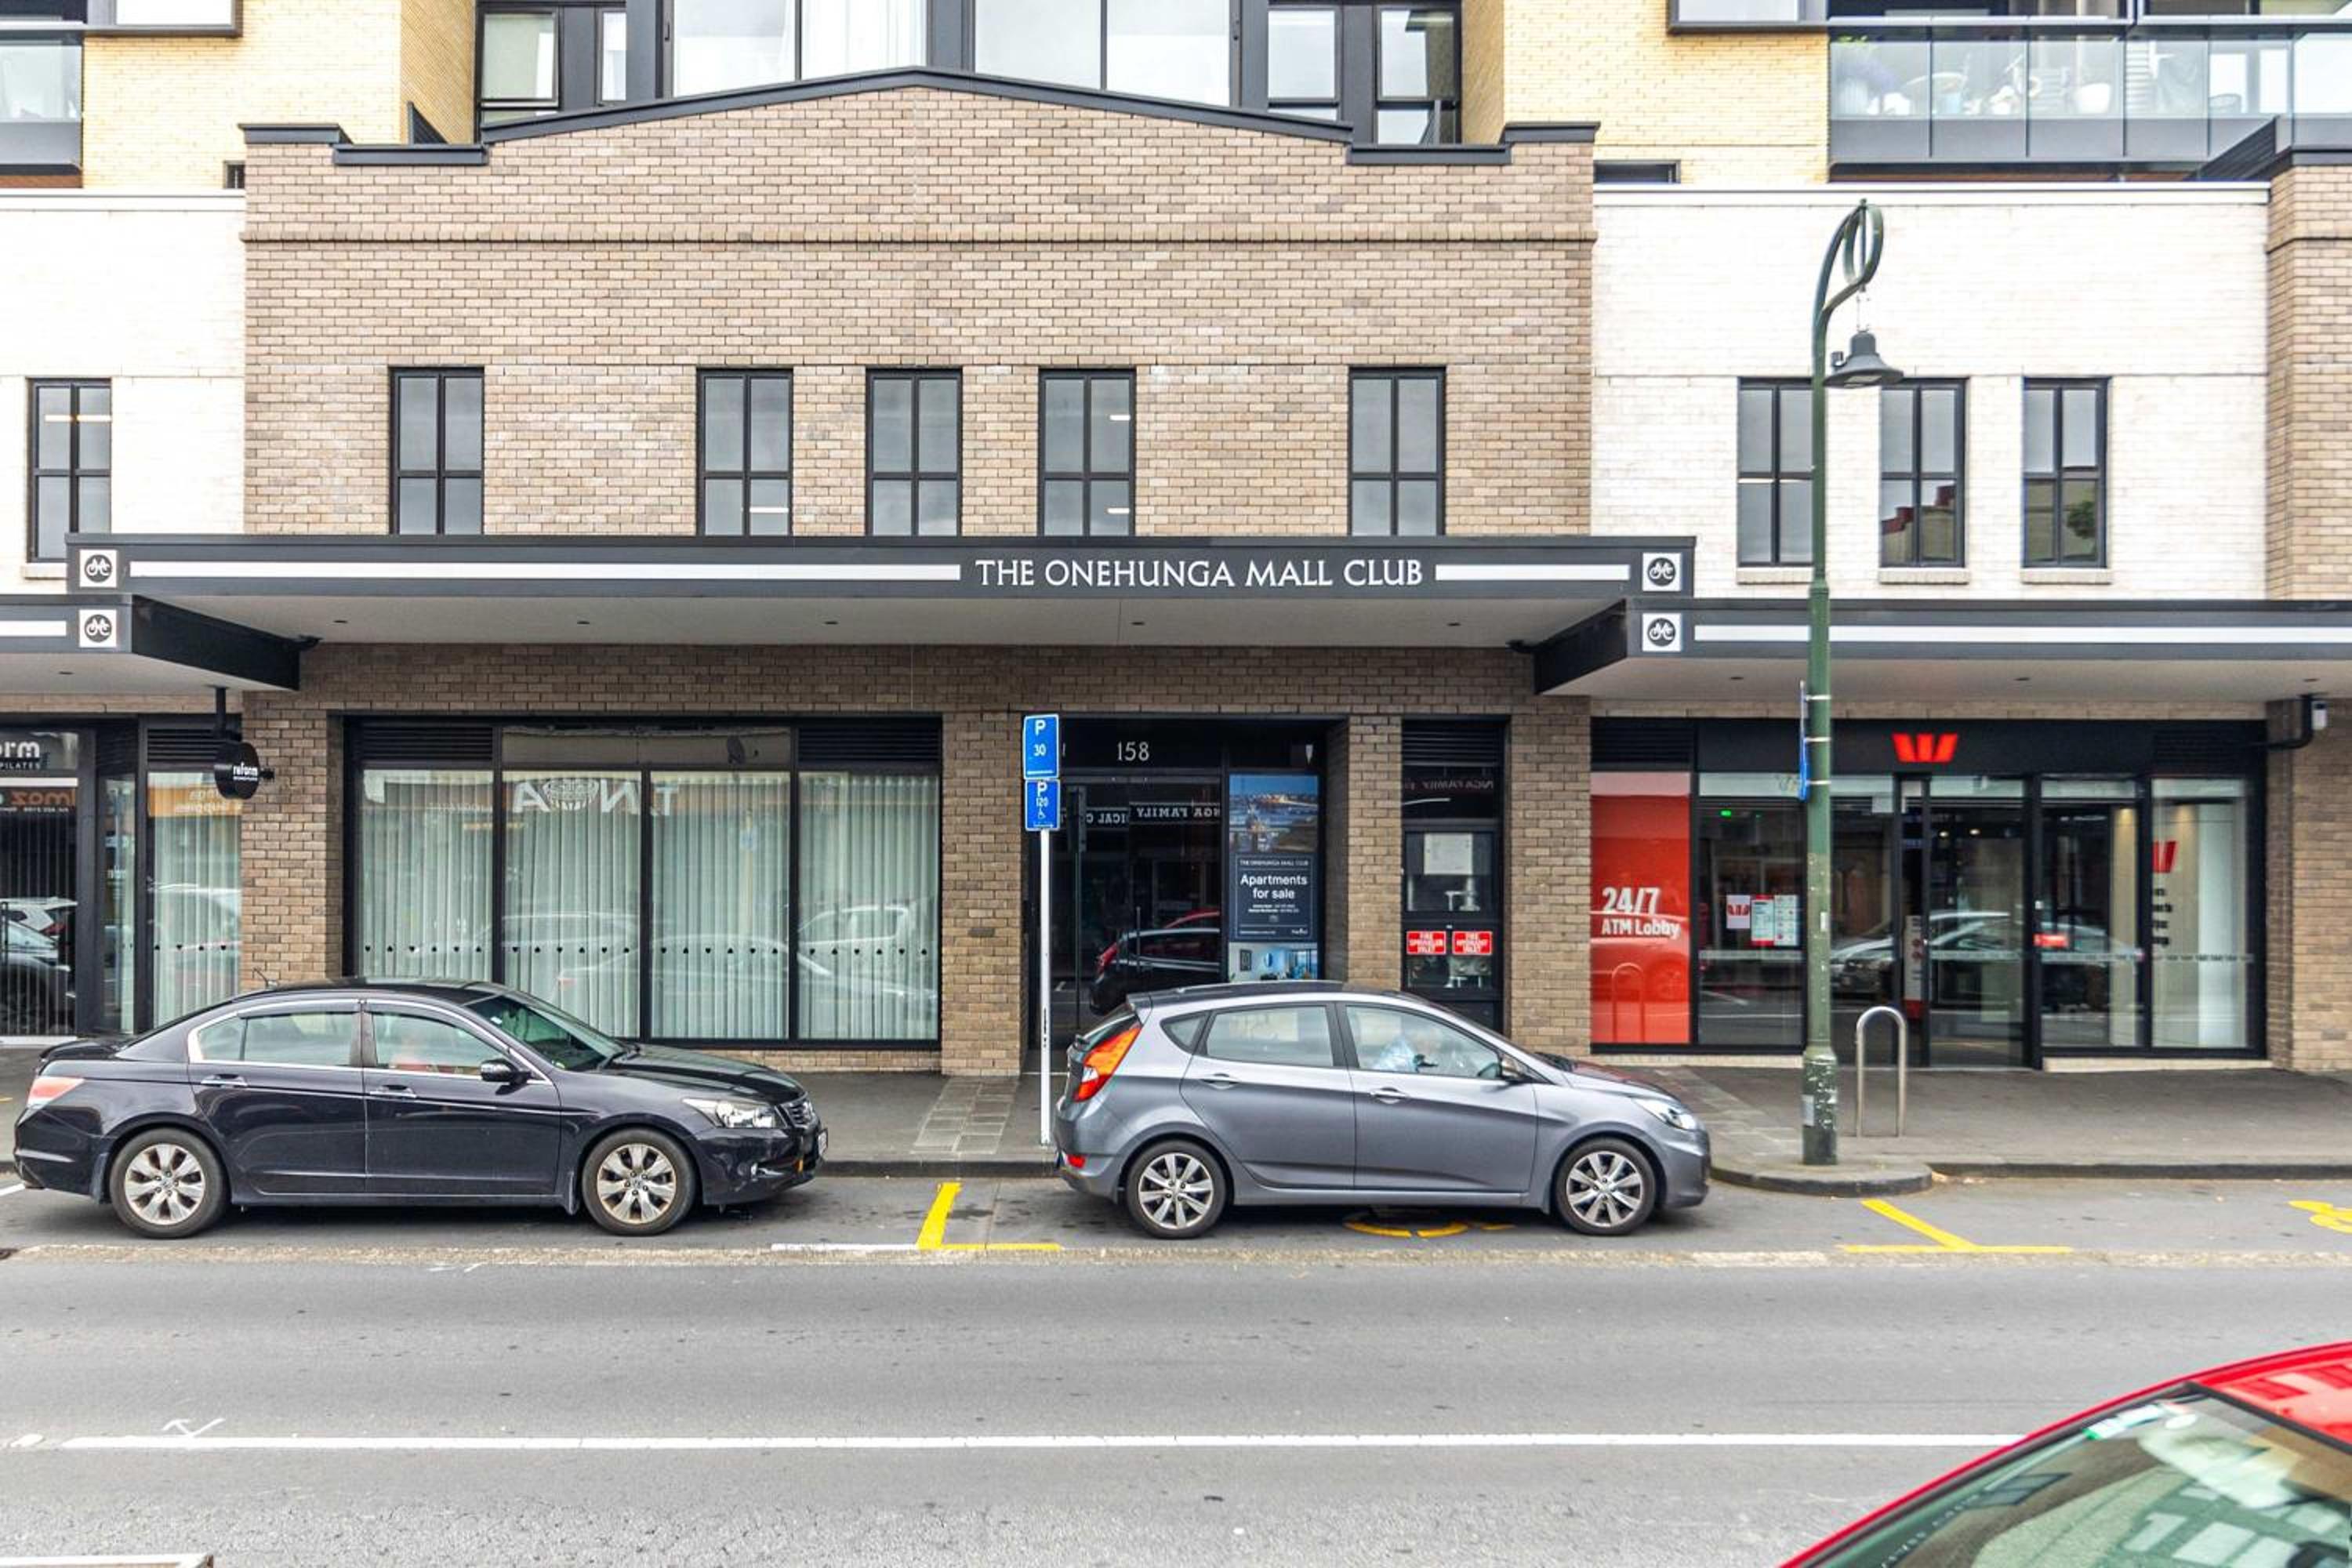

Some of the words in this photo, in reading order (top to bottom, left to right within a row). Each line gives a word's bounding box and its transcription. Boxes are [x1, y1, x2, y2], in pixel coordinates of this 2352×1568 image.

[975, 559, 1035, 586] THE
[1044, 559, 1236, 587] ONEHUNGA
[1244, 560, 1334, 587] MALL
[1343, 559, 1423, 586] CLUB
[1034, 719, 1047, 736] P
[1033, 742, 1047, 757] 30
[1116, 742, 1150, 762] 158
[1036, 781, 1048, 797] P
[1240, 873, 1308, 887] Apartments
[1252, 887, 1270, 899] for
[1271, 887, 1296, 899] sale
[1602, 886, 1661, 916] 24/7
[1602, 917, 1632, 935] ATM
[1634, 917, 1682, 941] Lobby
